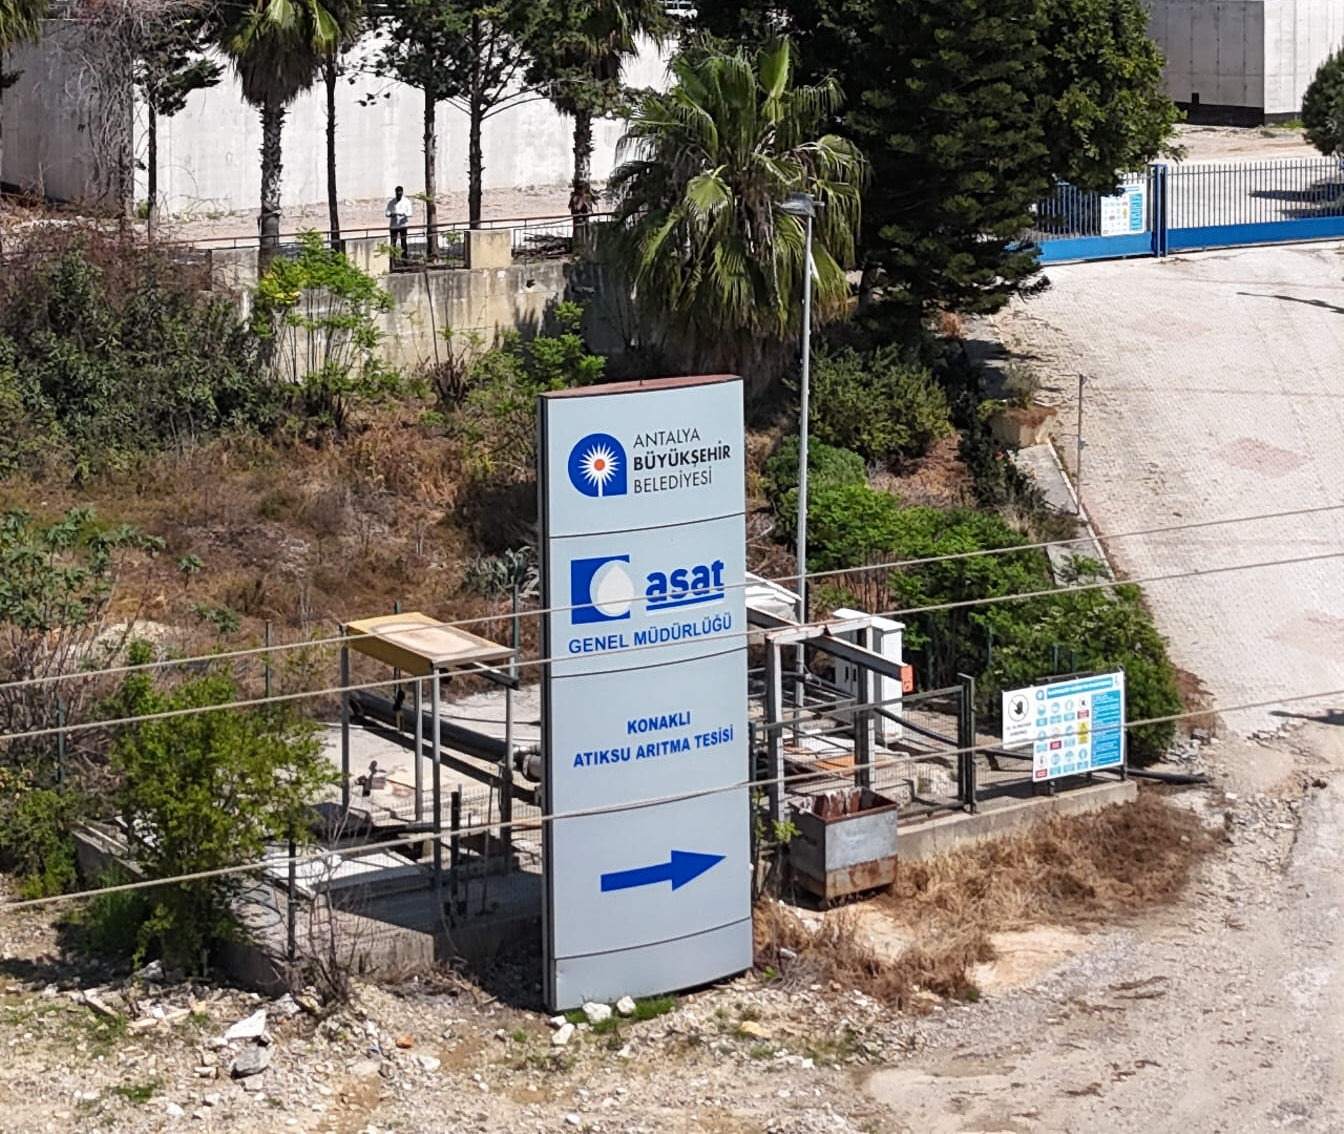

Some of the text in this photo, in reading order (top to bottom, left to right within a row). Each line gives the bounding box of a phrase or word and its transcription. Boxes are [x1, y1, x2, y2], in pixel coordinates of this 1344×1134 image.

[633, 428, 700, 448] ANTALYA
[633, 440, 731, 471] BÜYÜKŞEHİR
[634, 466, 712, 494] BELEDİYESİ
[645, 560, 724, 603] asat
[568, 613, 732, 653] GENEL MÜDÜRLÜĞÜ
[627, 711, 691, 735] KONAKLI
[573, 724, 734, 768] ATIKSU ARITMA TESİSİ
